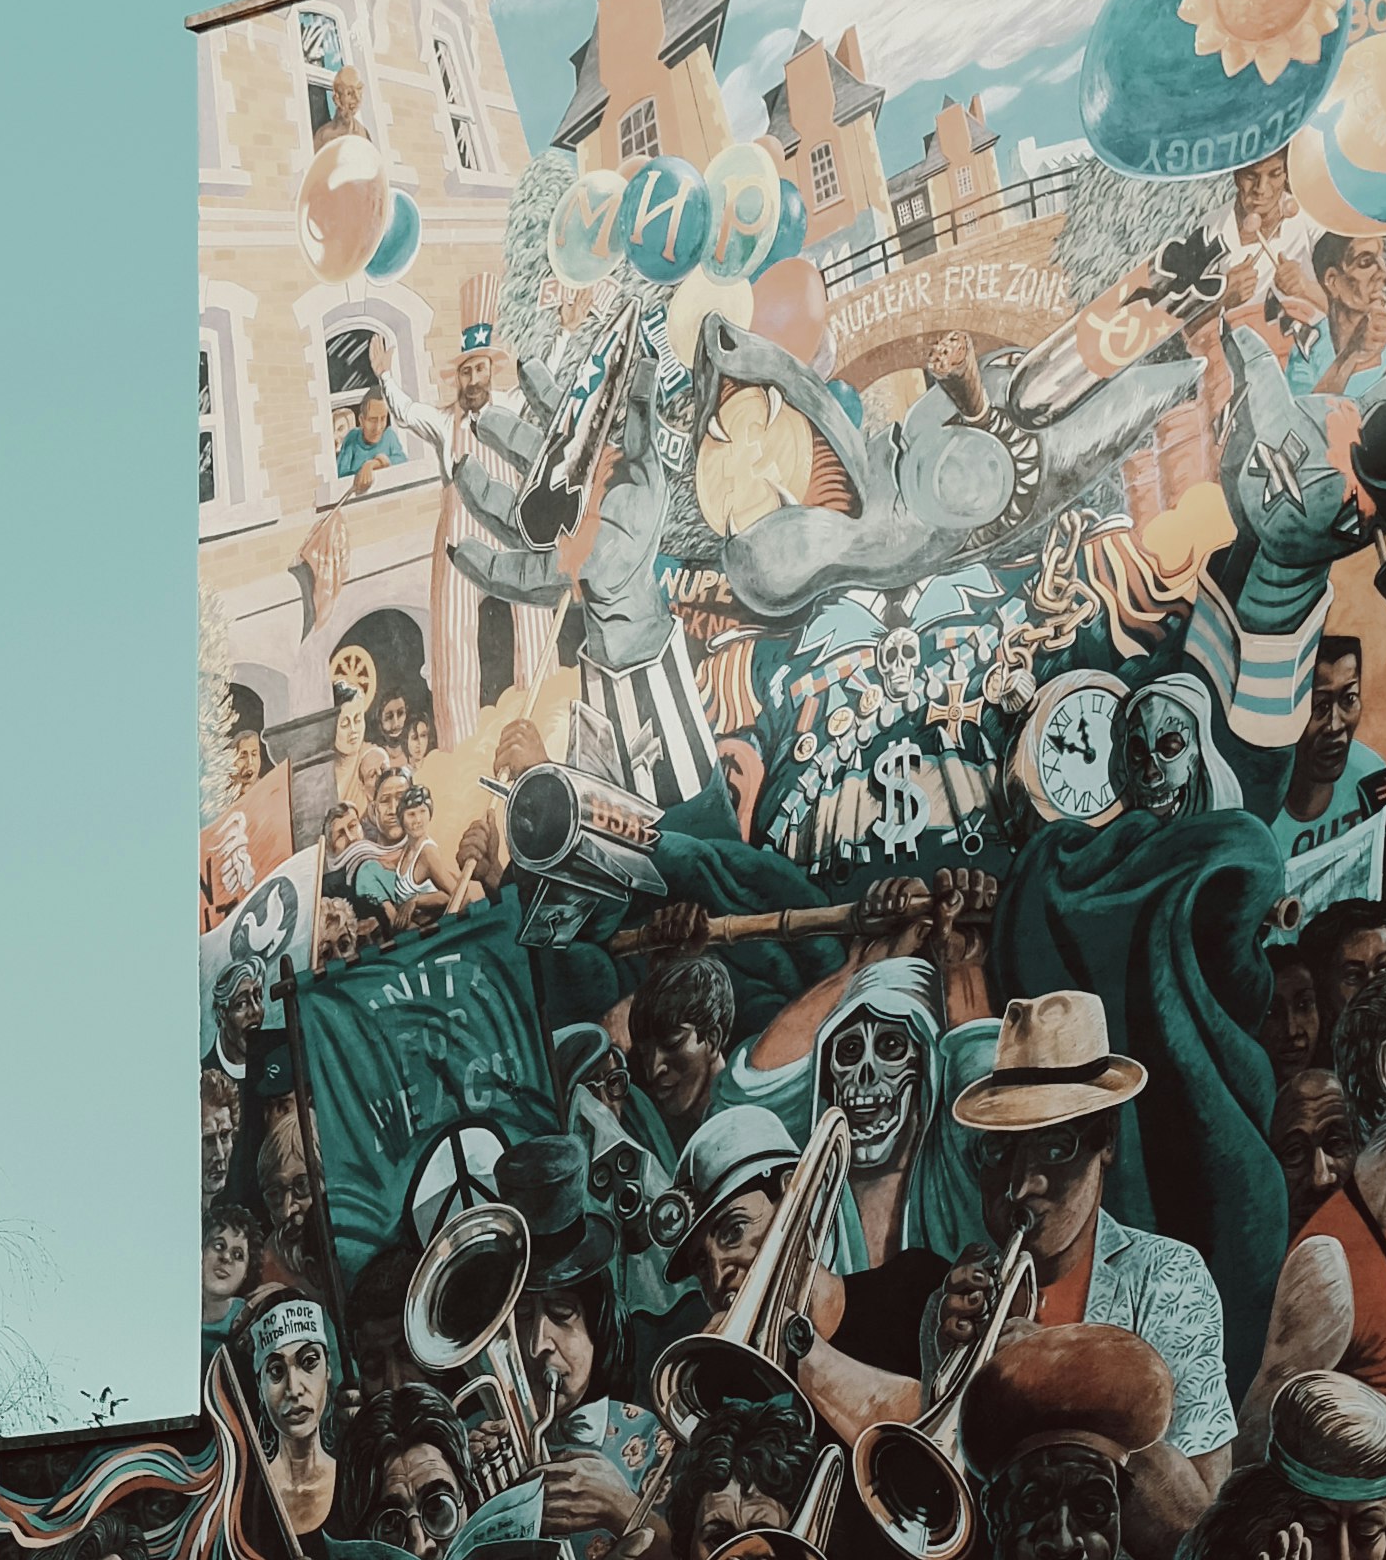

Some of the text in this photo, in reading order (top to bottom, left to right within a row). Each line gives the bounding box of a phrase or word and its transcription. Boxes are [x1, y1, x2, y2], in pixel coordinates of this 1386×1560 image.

[1140, 96, 1306, 174] ECOLOGY
[829, 272, 933, 339] NUCLEAR
[944, 263, 1003, 302] FREE
[258, 1315, 318, 1351] hiroshimas
[262, 1306, 313, 1330] no more
